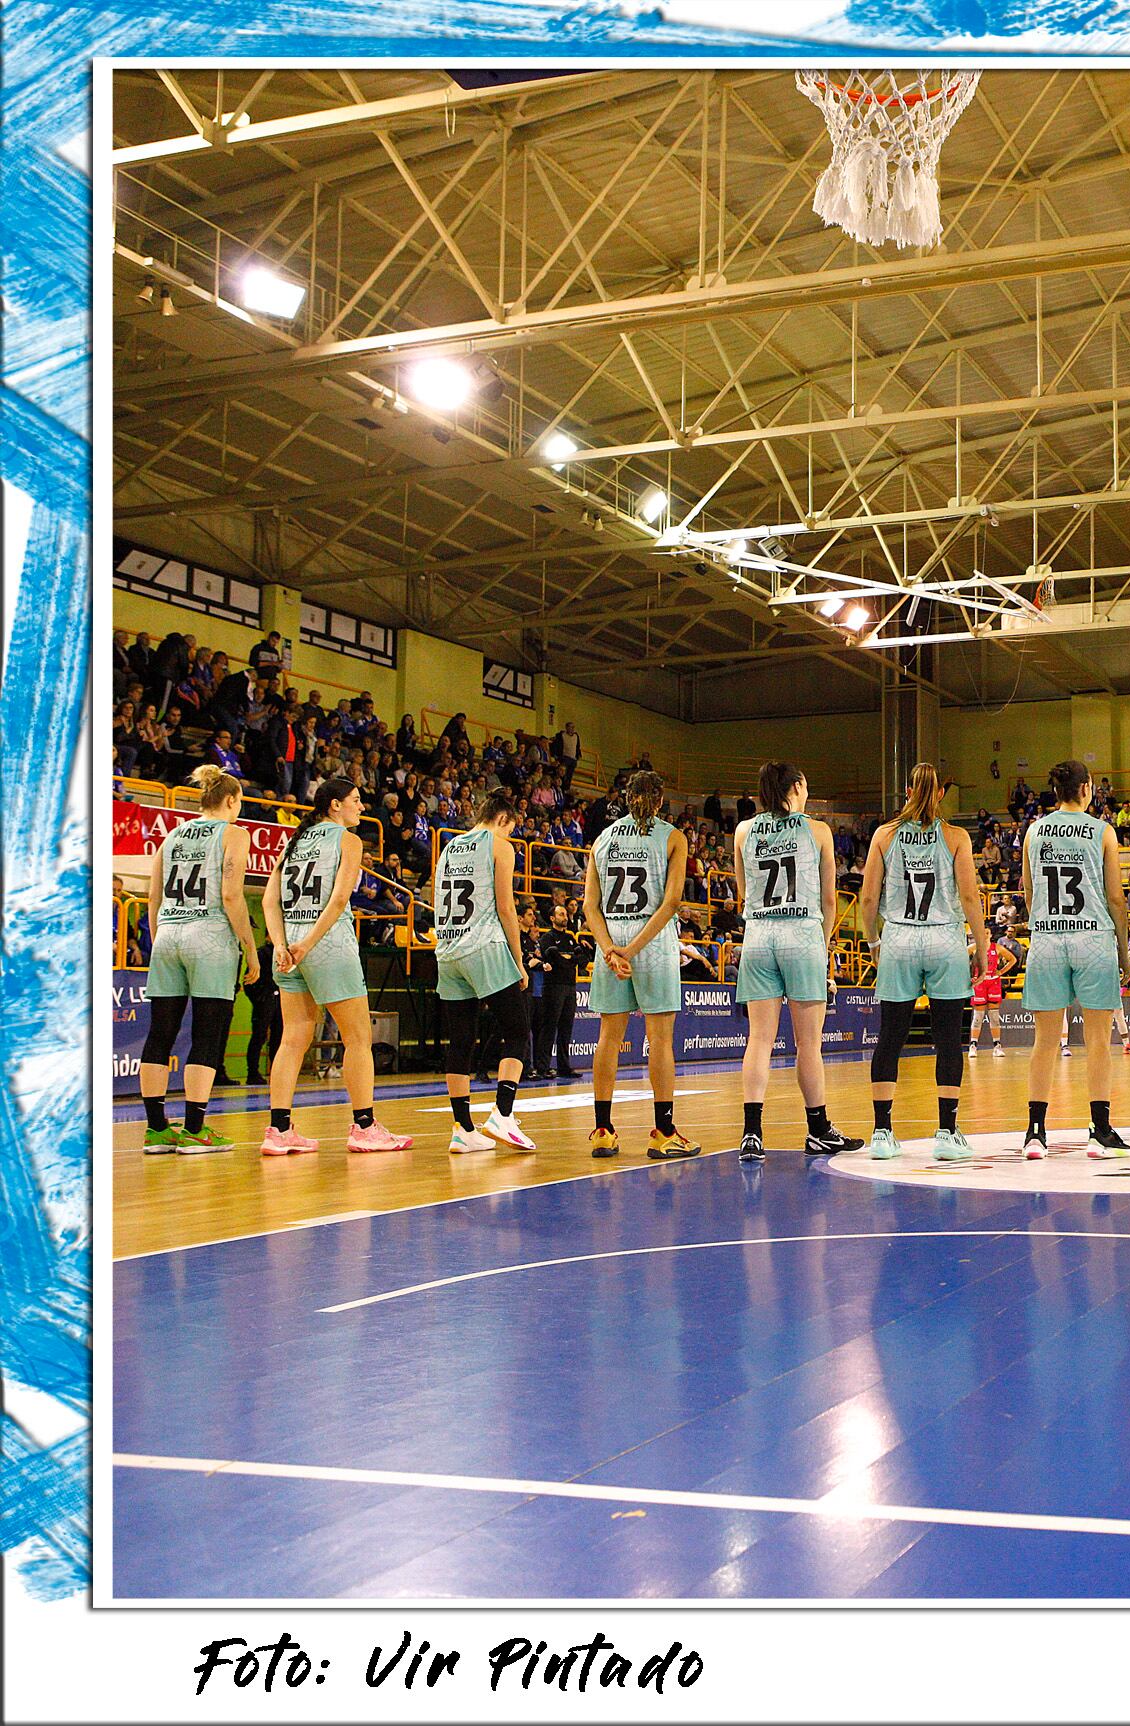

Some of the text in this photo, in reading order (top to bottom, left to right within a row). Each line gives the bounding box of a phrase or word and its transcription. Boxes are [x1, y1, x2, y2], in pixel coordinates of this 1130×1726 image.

[1037, 823, 1095, 840] ARAGONÉS
[164, 863, 207, 907] 44
[283, 861, 322, 910] 34
[606, 866, 649, 914] 23
[758, 855, 797, 908] 21
[903, 870, 936, 921] 17
[1042, 865, 1085, 916] 13
[1034, 919, 1098, 932] SALAMANCA
[684, 991, 732, 1006] SALAMANCA
